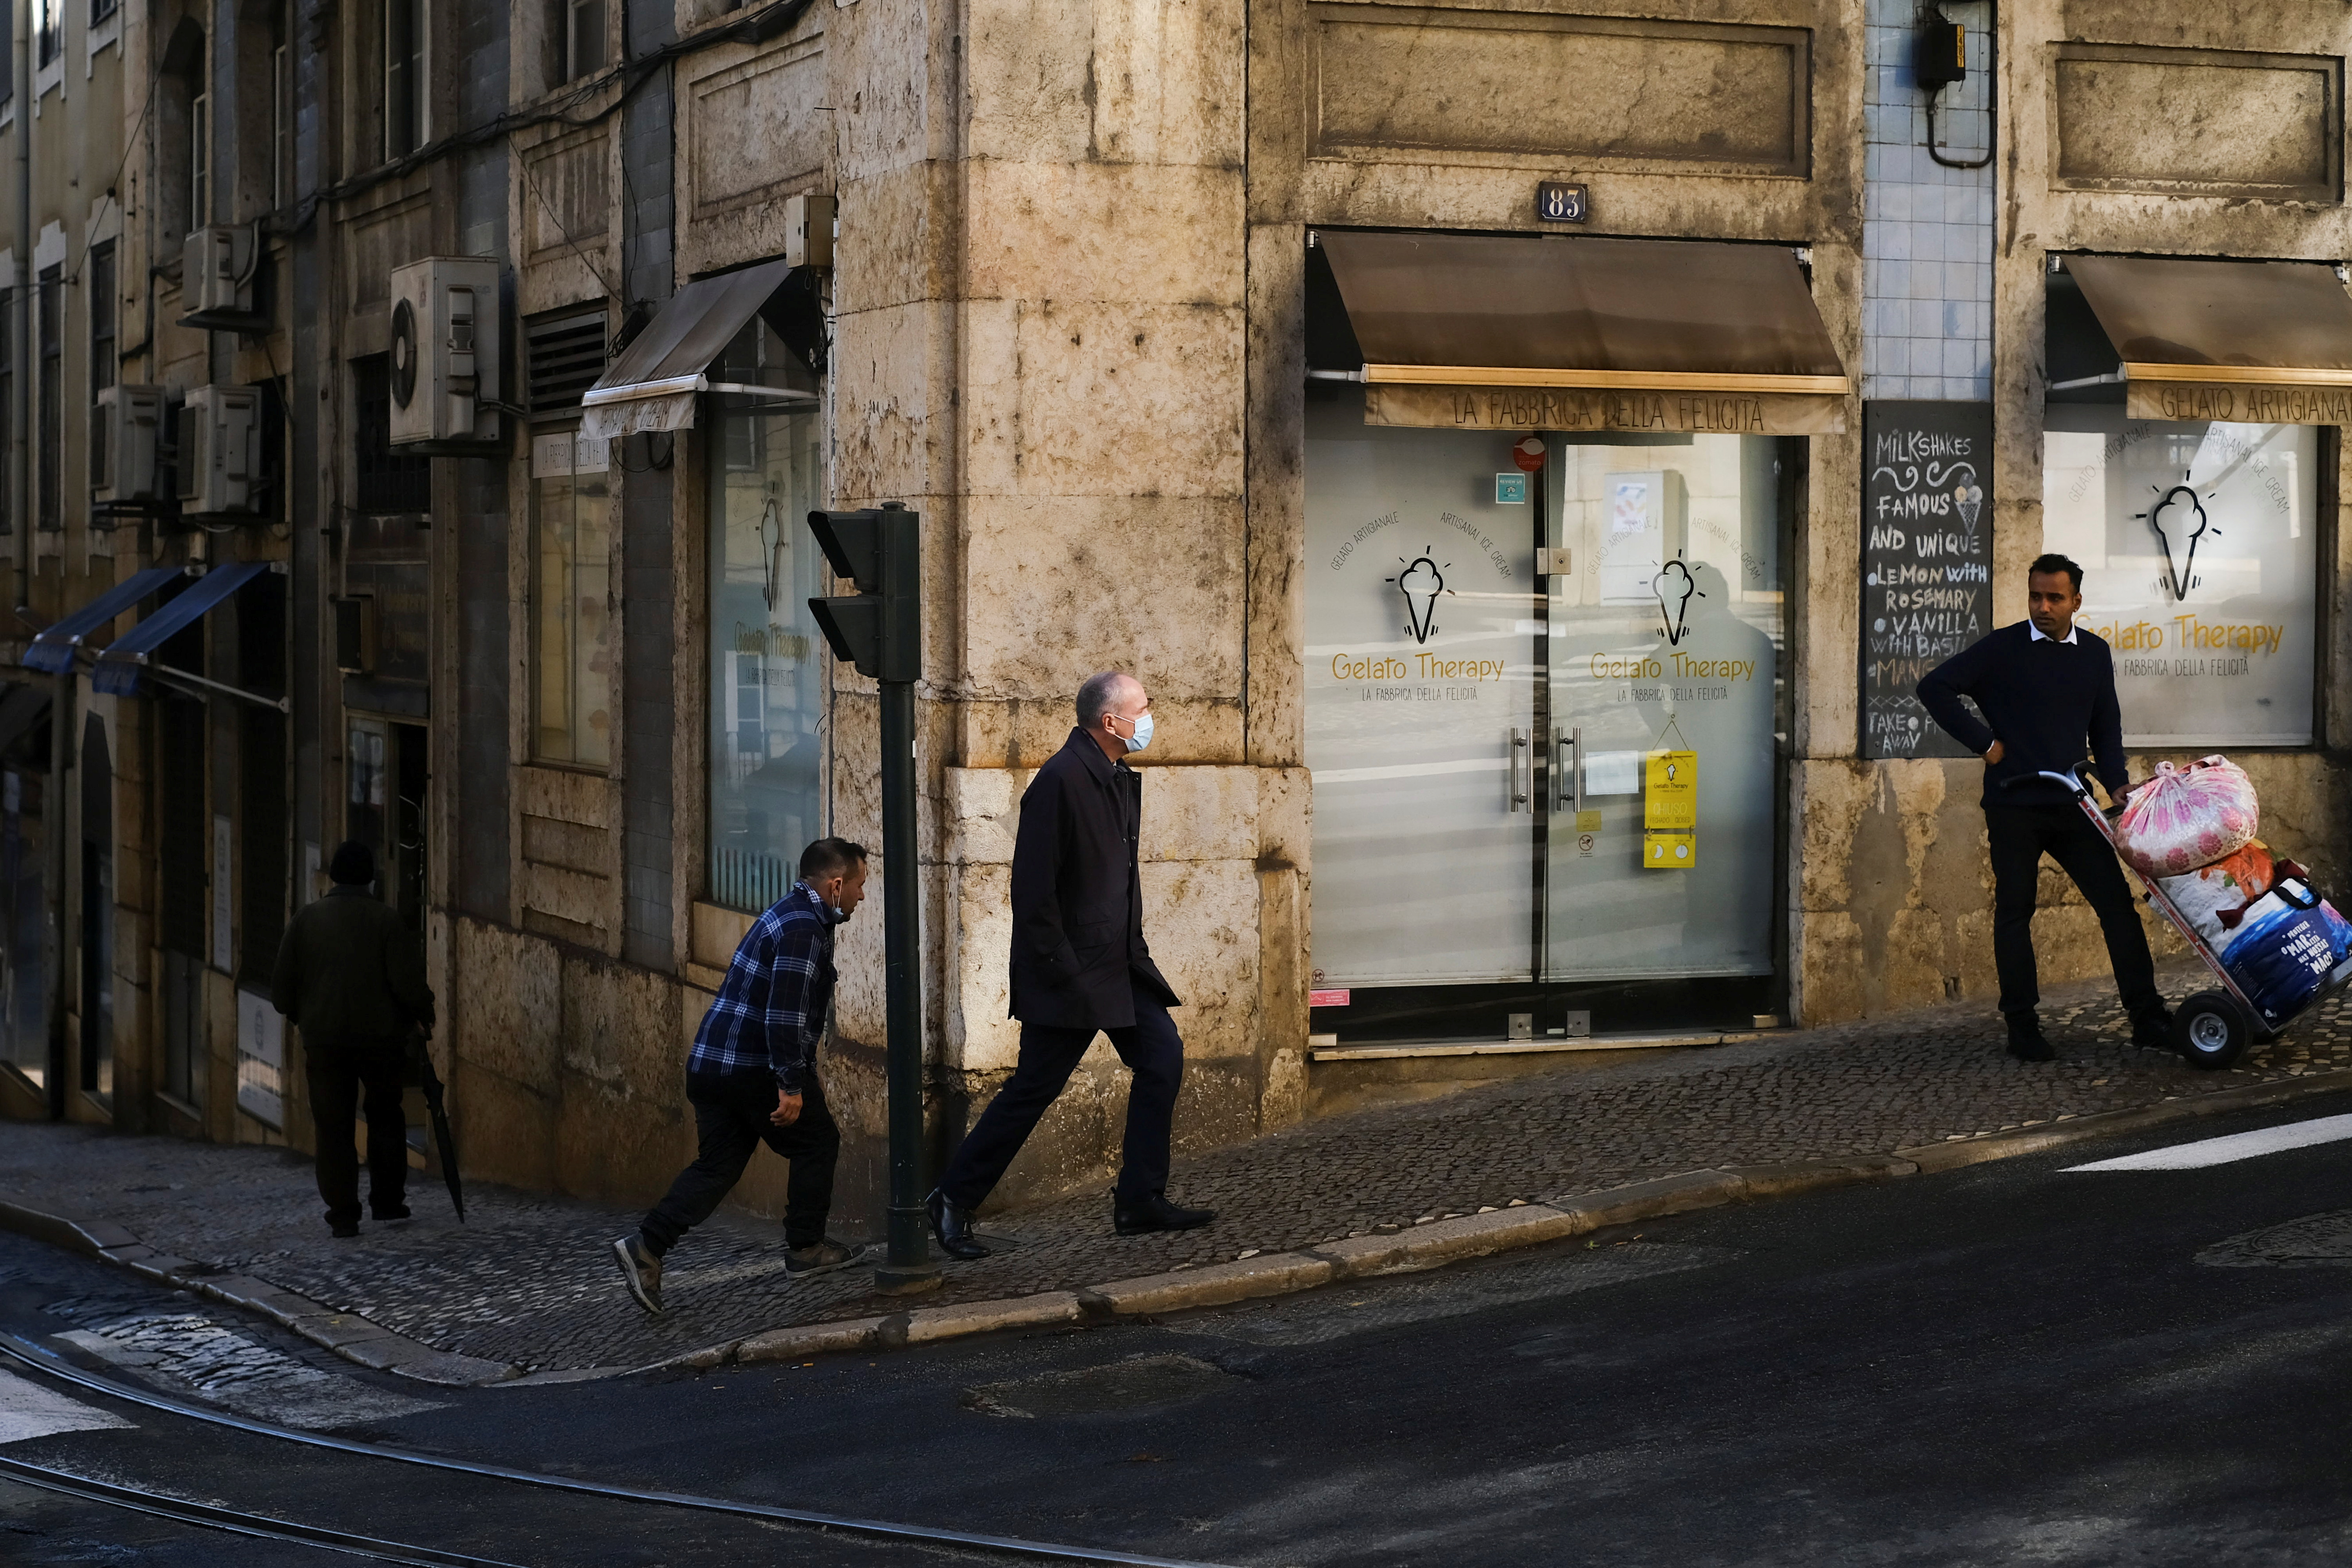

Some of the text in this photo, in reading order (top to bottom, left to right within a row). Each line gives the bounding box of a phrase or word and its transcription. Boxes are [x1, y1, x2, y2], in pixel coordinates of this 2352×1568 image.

[1549, 188, 1579, 217] 83
[1453, 392, 1764, 431] LA FABBRICA DELLA FELICITÀ
[2161, 387, 2233, 419] GELATO
[2069, 423, 2152, 504] GELATO ARTIGIANALE
[2203, 425, 2290, 514] ARTISANAL ICE CREAM
[1876, 492, 1950, 520] FAMOUS
[1330, 511, 1399, 570] GELATO ARTIGIANALE
[1440, 512, 1512, 579] ARTISANAL ICE CREAM
[1587, 516, 1652, 575] GELATO ARTIGIANALE
[1692, 517, 1760, 580] ARTISANAL ICE CREAM
[1869, 524, 1905, 550] AND
[1878, 561, 1944, 586] LEMON
[2174, 614, 2283, 653] Therapy
[1333, 652, 1504, 682] Gelato Therapy
[1591, 652, 1755, 681] Gelato Therapy
[2124, 659, 2169, 676] FABBRICA
[2175, 659, 2205, 676] DELLA
[2211, 656, 2249, 676] FELICITÀ
[1362, 686, 1477, 701] LA FABBRICA DELLA FELICITÀ
[1618, 685, 1728, 702] LA FABBRICA DELLA FELICITÀ
[1868, 711, 1906, 734] TAKE
[1883, 731, 1920, 755] AWAY
[1653, 802, 1687, 815] CHIUSO
[2281, 947, 2288, 955] O
[2287, 934, 2312, 956] MAR
[2298, 938, 2329, 964] NAS NOSSAS
[2310, 953, 2333, 975] MÃOS
